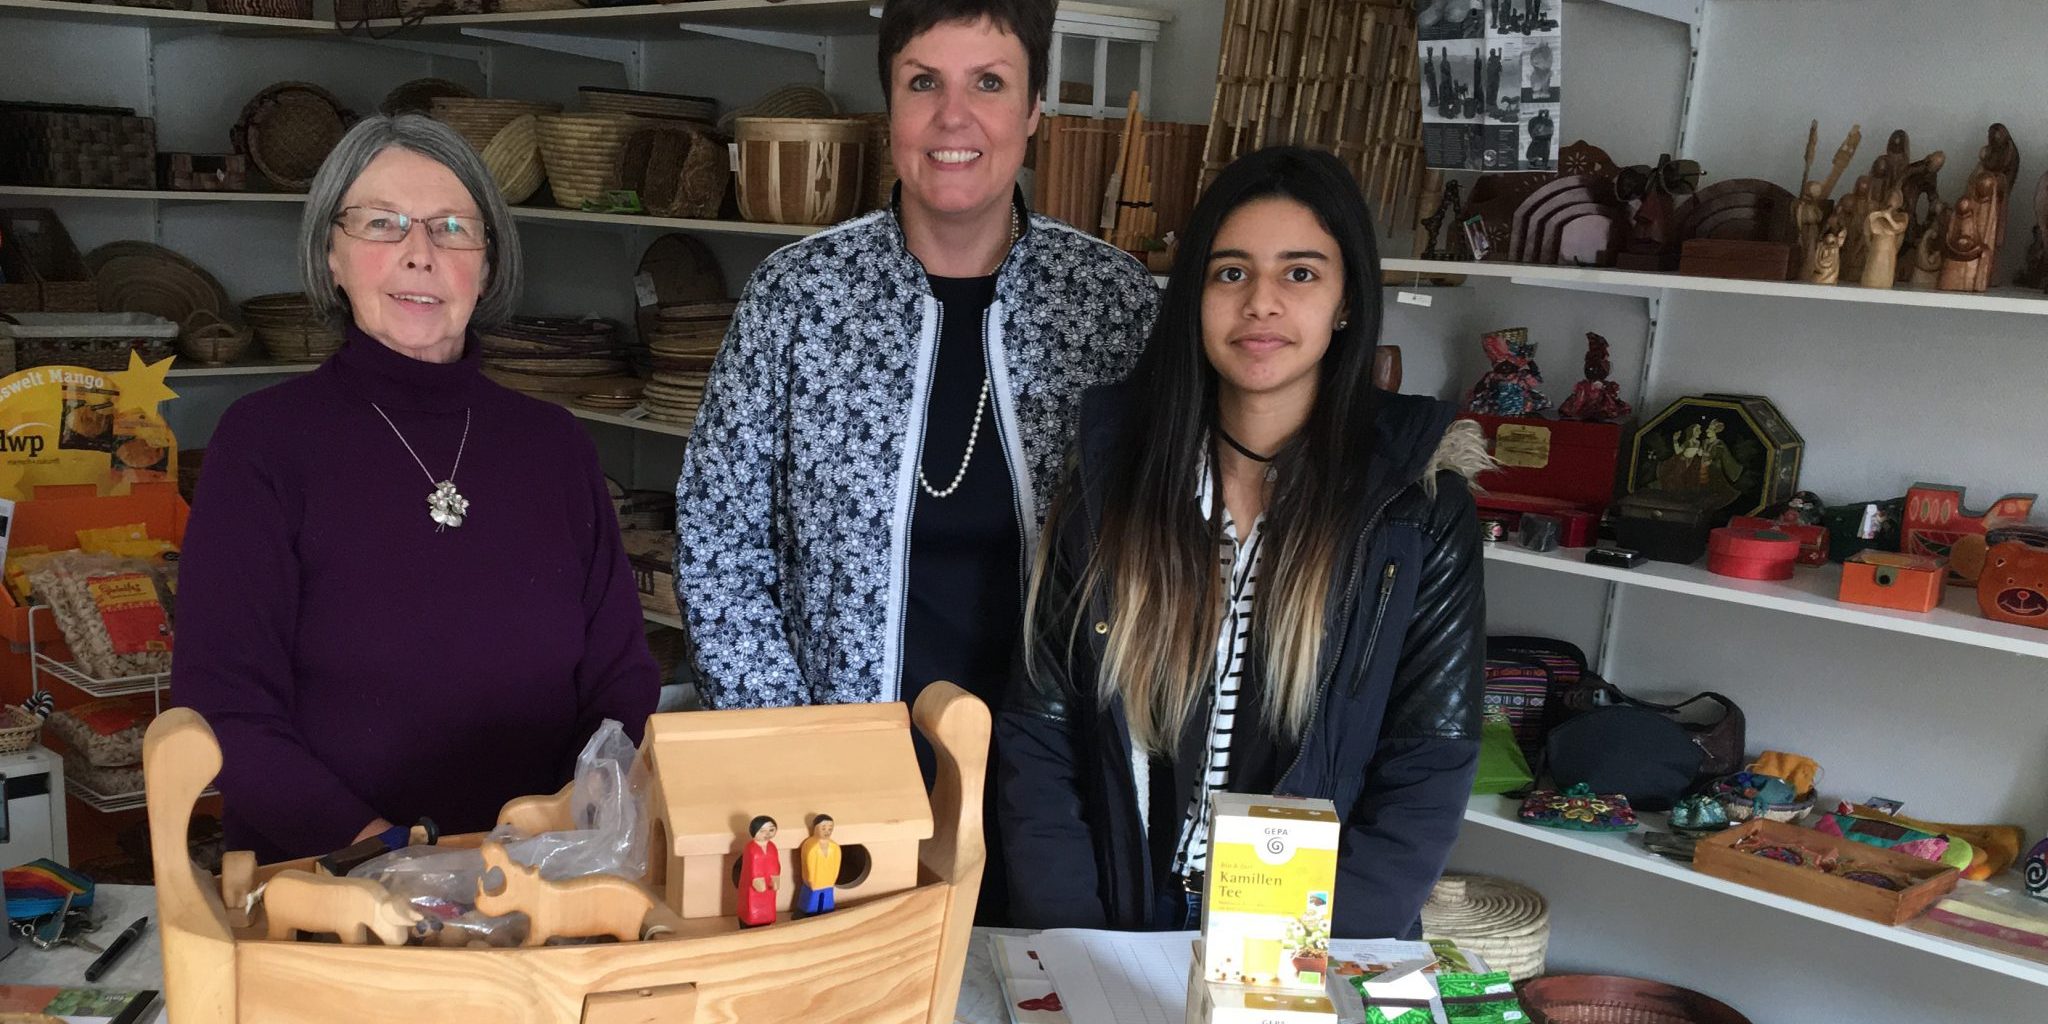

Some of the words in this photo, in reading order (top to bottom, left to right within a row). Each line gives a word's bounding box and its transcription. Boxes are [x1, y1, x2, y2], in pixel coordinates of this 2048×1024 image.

[48, 368, 104, 389] Mango
[1264, 827, 1288, 836] GEPA
[1220, 871, 1283, 886] Kamillen
[1219, 886, 1242, 898] Tee
